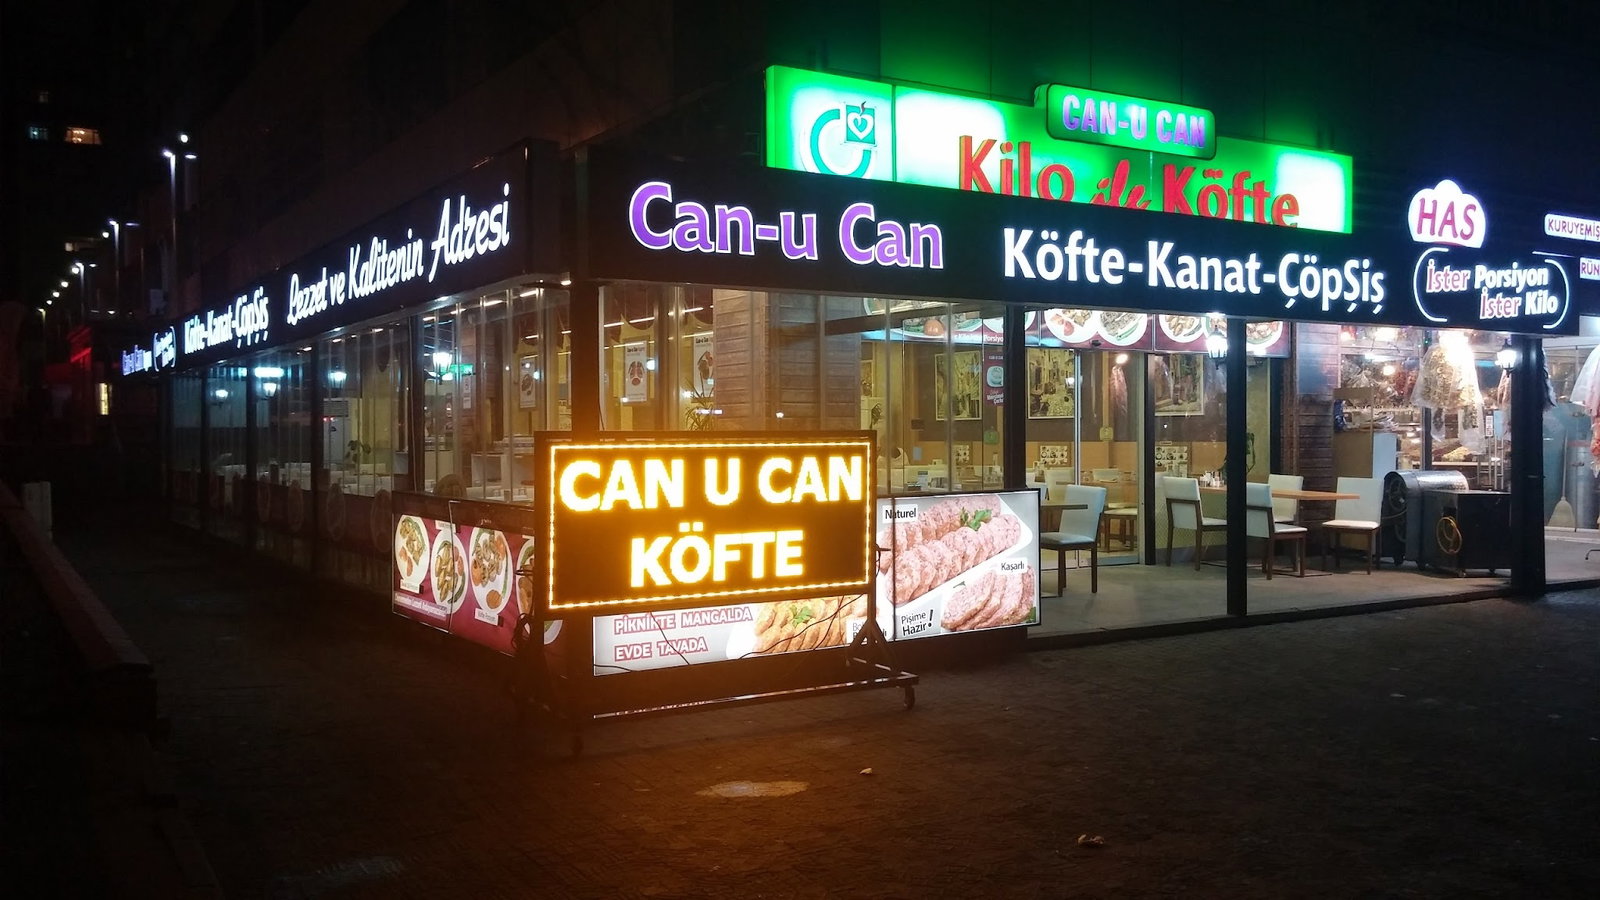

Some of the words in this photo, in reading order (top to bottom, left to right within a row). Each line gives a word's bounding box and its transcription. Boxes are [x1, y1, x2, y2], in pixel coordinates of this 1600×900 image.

[1062, 94, 1147, 140] CAN-U
[1156, 110, 1206, 149] CAN
[959, 135, 1076, 201] Kilo
[1090, 159, 1151, 211] ile
[1163, 164, 1300, 228] Köfte
[629, 181, 819, 261] Can-u
[839, 202, 945, 270] Can
[1416, 197, 1477, 241] HAS
[286, 266, 327, 325] Lezzet
[330, 271, 346, 306] ve
[347, 228, 424, 300] Kalitenin
[428, 182, 510, 284] Adresi
[1003, 226, 1386, 314] Köfte-Kanat-ÇöpŞiş
[1580, 260, 1600, 277] RÜN
[1426, 258, 1471, 293] İster
[1474, 261, 1549, 294] Porsiyon
[1479, 286, 1522, 320] İster
[1524, 289, 1559, 316] Kilo
[984, 334, 1004, 344] Porsiyo
[560, 458, 685, 512] CAN
[703, 457, 741, 506] U
[757, 455, 863, 504] CAN
[629, 520, 804, 588] KÖFTE
[1000, 560, 1025, 575] Kaşarlı
[614, 613, 676, 636] PİKNİKTE
[680, 606, 754, 629] MANGALDA
[900, 612, 927, 626] Pişime
[614, 642, 653, 663] EVDE
[656, 636, 709, 658] TAVADA
